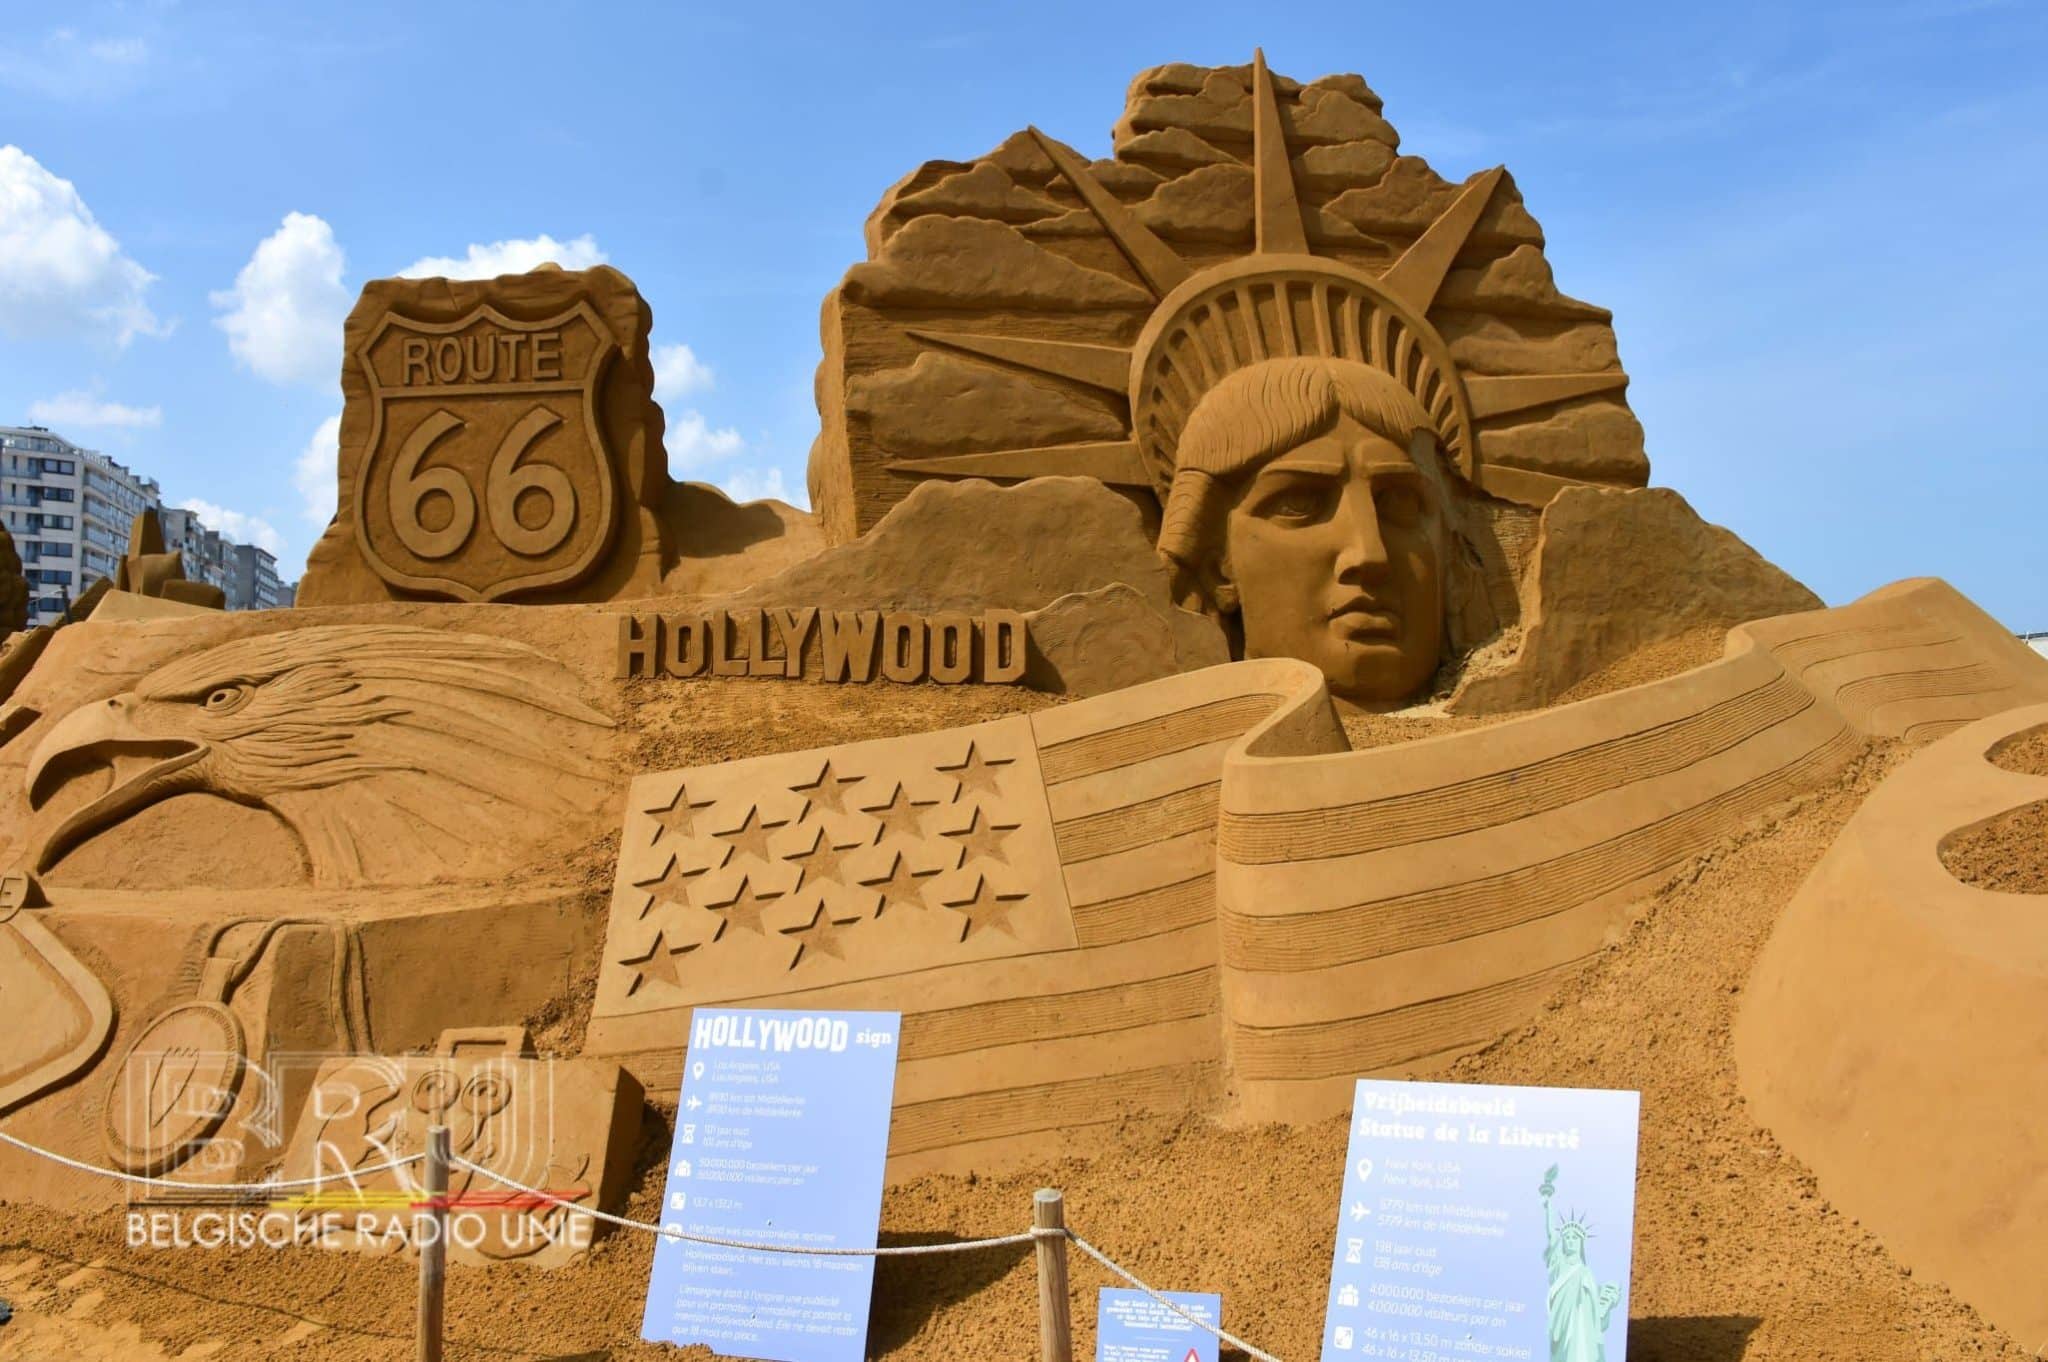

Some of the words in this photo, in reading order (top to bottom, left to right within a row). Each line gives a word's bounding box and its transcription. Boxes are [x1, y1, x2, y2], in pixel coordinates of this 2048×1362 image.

[403, 332, 561, 386] ROUTE
[389, 406, 577, 559] 66
[617, 607, 1028, 684] HOLLYWOOD
[694, 1015, 849, 1052] HOLLYWOOD
[855, 1027, 893, 1048] sign
[1363, 1091, 1517, 1116] Vrijheidsbeeld
[1359, 1117, 1425, 1139] Statue
[1434, 1123, 1459, 1142] de
[1467, 1121, 1490, 1144] la
[1499, 1125, 1581, 1150] Liberté
